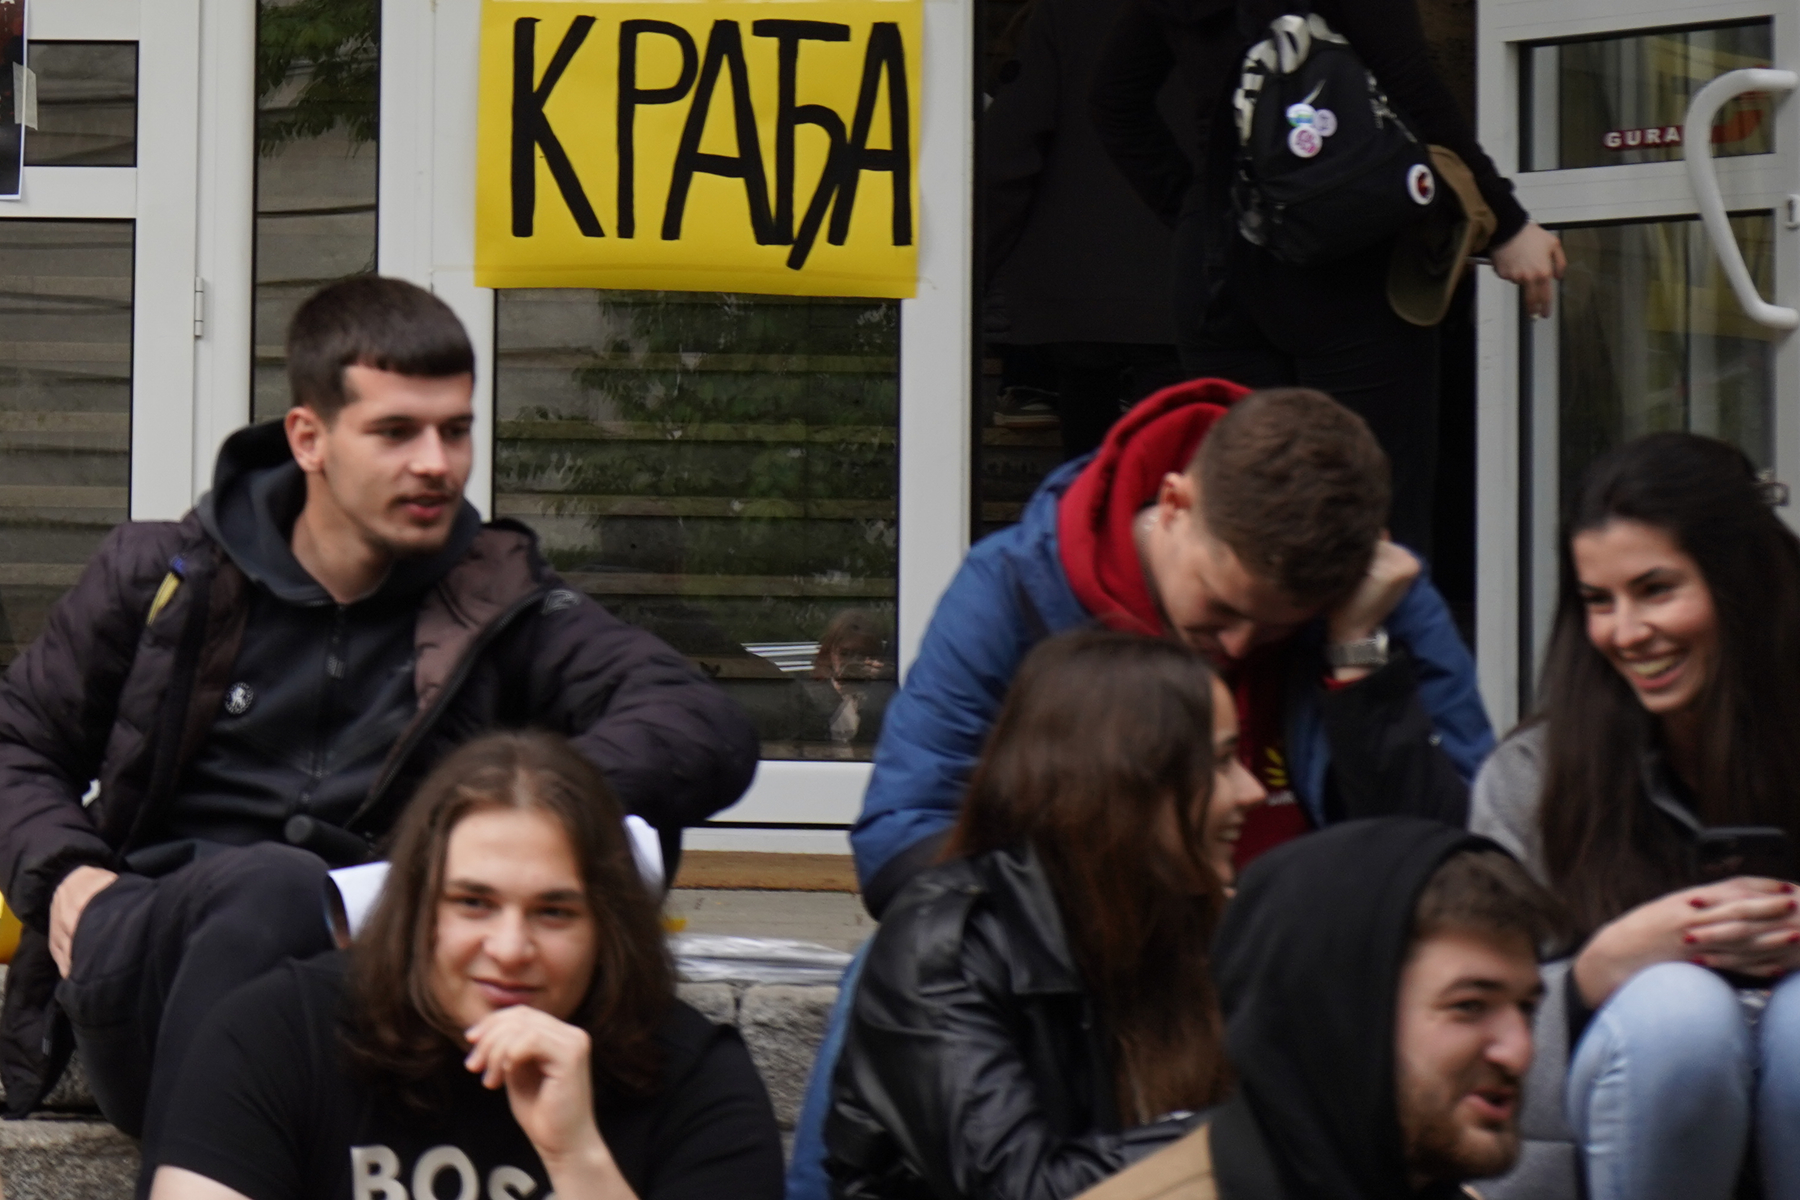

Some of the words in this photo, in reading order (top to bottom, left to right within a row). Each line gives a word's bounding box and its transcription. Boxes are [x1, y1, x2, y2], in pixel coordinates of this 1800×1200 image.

[510, 15, 912, 271] КРАЂА
[1603, 126, 1681, 147] GURA
[351, 1145, 556, 1200] BOS
